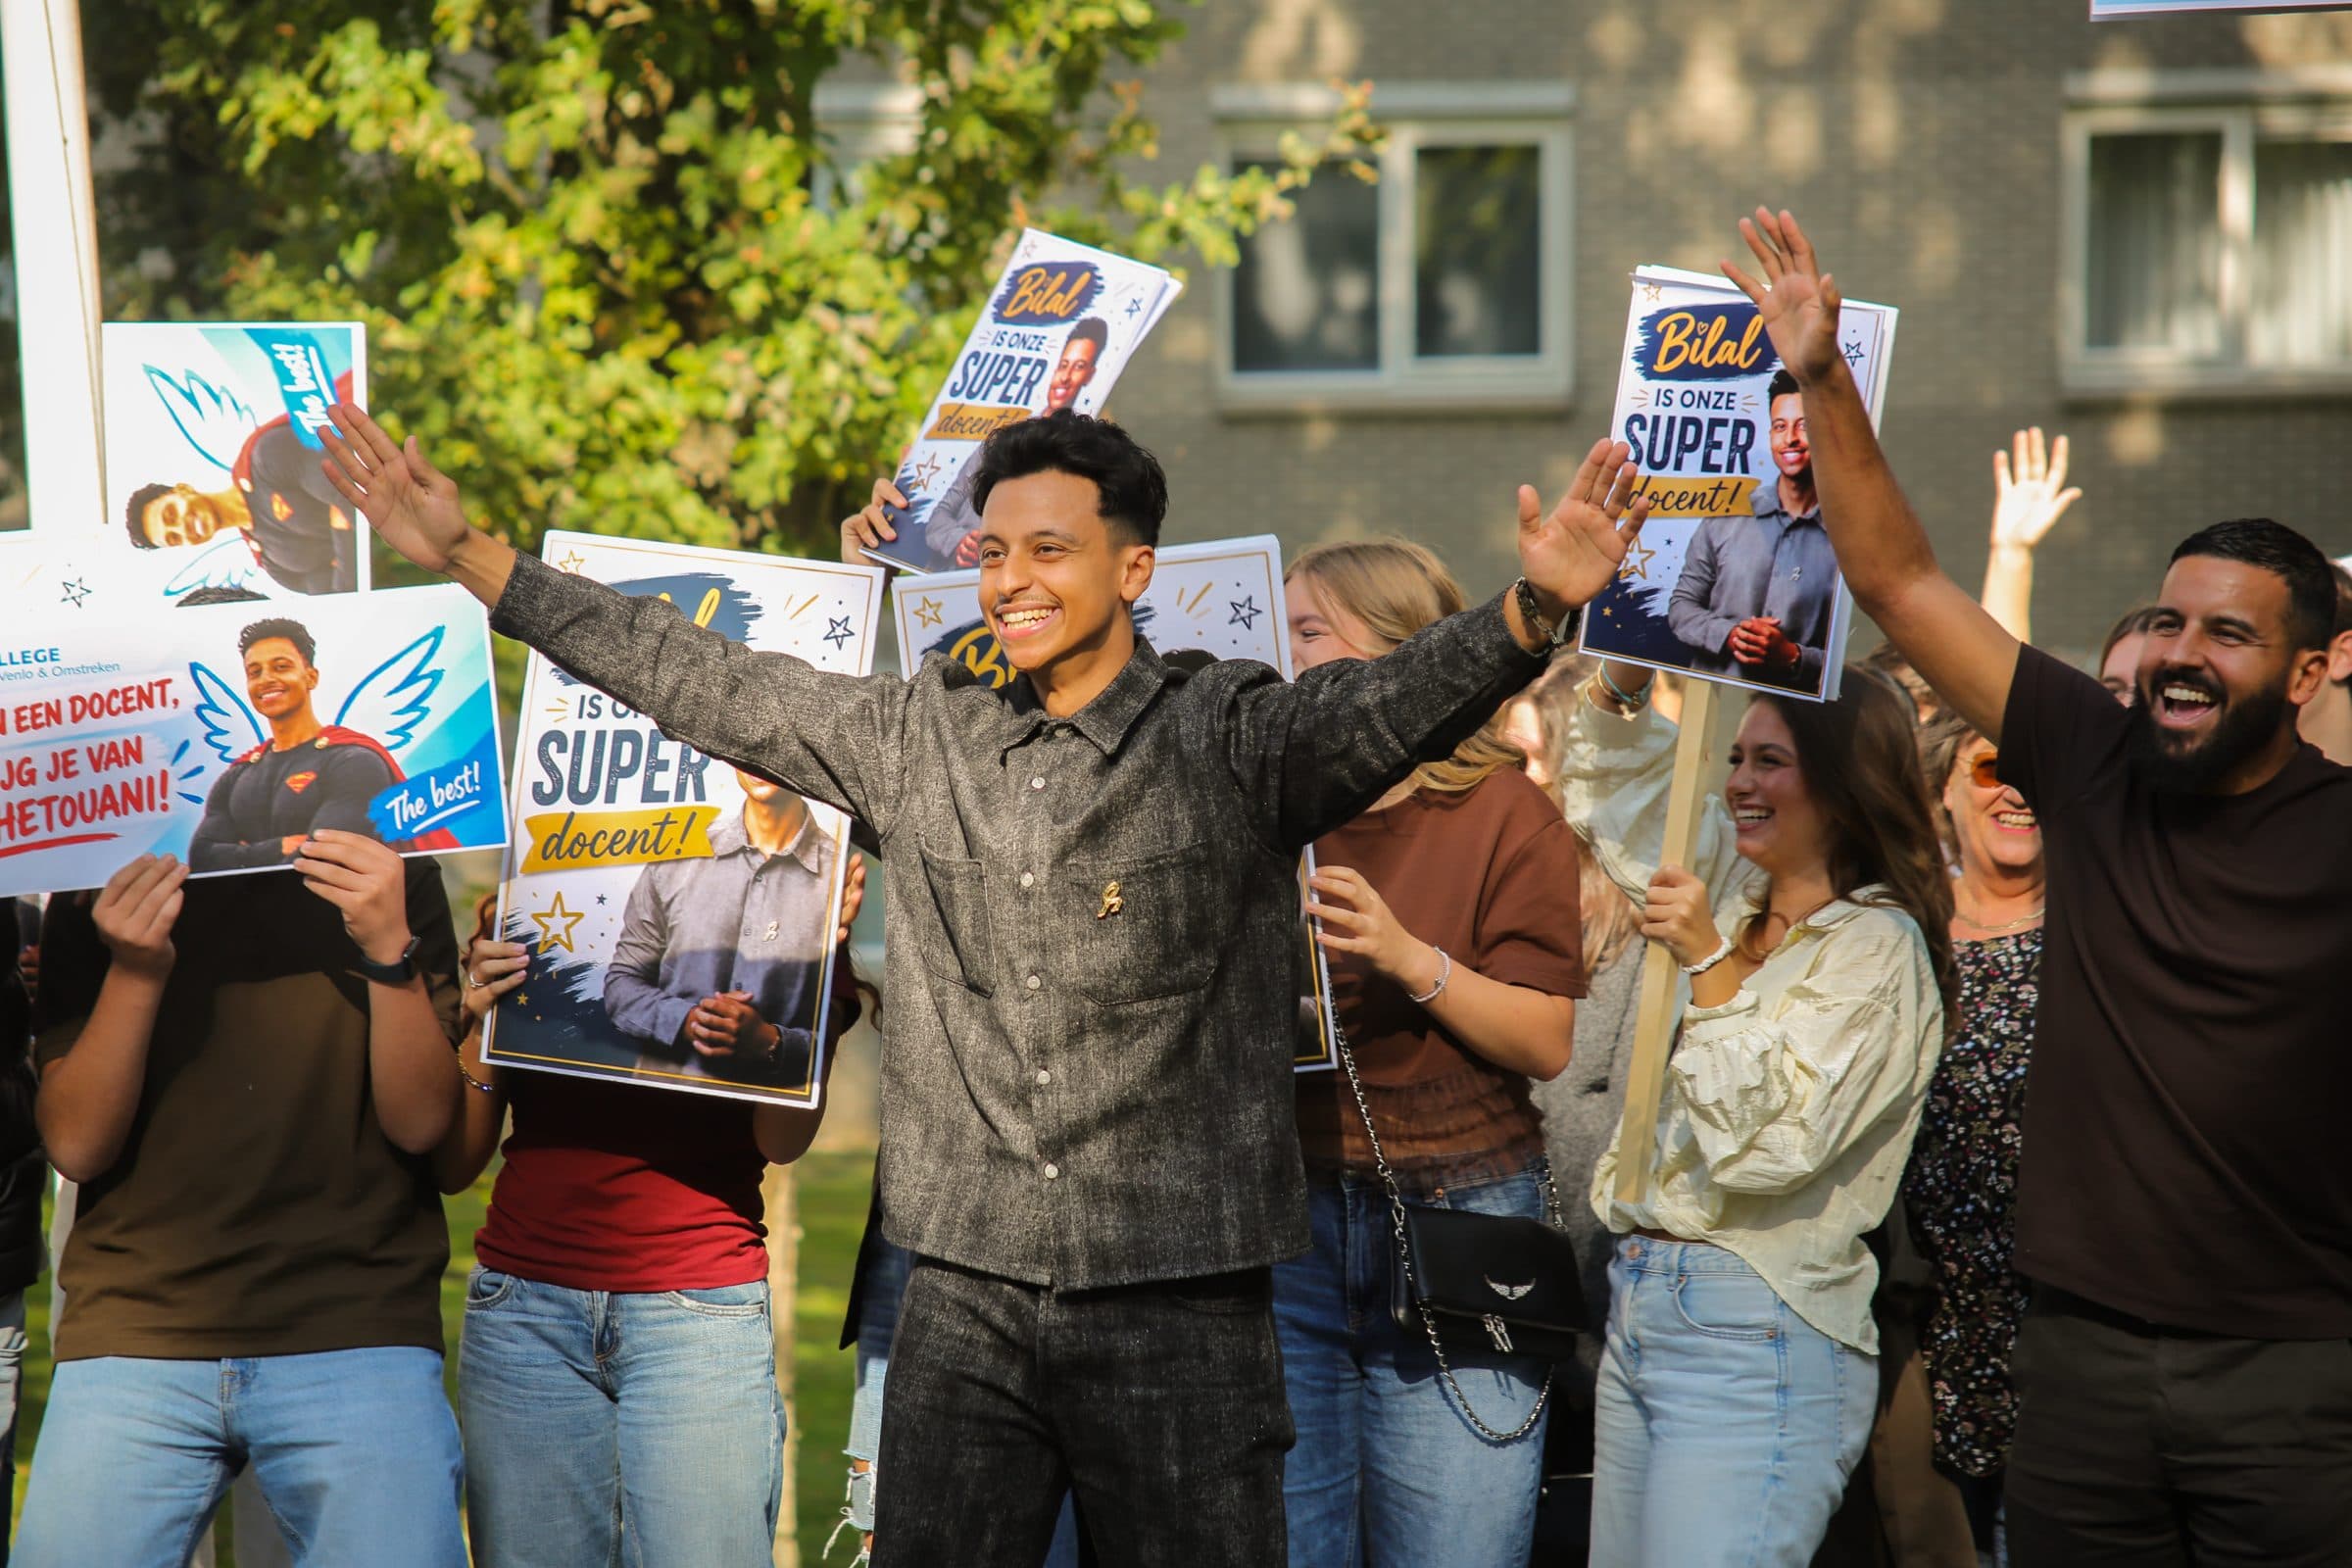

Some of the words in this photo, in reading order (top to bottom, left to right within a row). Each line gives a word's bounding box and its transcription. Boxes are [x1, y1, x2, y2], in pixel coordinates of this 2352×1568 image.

[1003, 267, 1091, 318] Bilal
[991, 330, 1008, 347] IS
[1008, 330, 1048, 352] ONZE
[1652, 312, 1765, 372] Bilal
[949, 350, 1049, 406] SUPER
[1654, 388, 1674, 408] IS
[1680, 389, 1738, 411] ONZE
[1625, 414, 1756, 474] SUPER
[1626, 474, 1742, 514] docent!
[37, 666, 49, 678] &
[52, 662, 121, 677] Omstreken
[14, 699, 63, 733] EEN
[69, 678, 179, 724] DOCENT,
[578, 694, 604, 719] IS
[46, 748, 79, 782] JE
[86, 735, 143, 773] VAN
[531, 729, 712, 806] SUPER
[385, 789, 427, 831] The
[429, 760, 481, 808] best!
[541, 810, 698, 861] docent!
